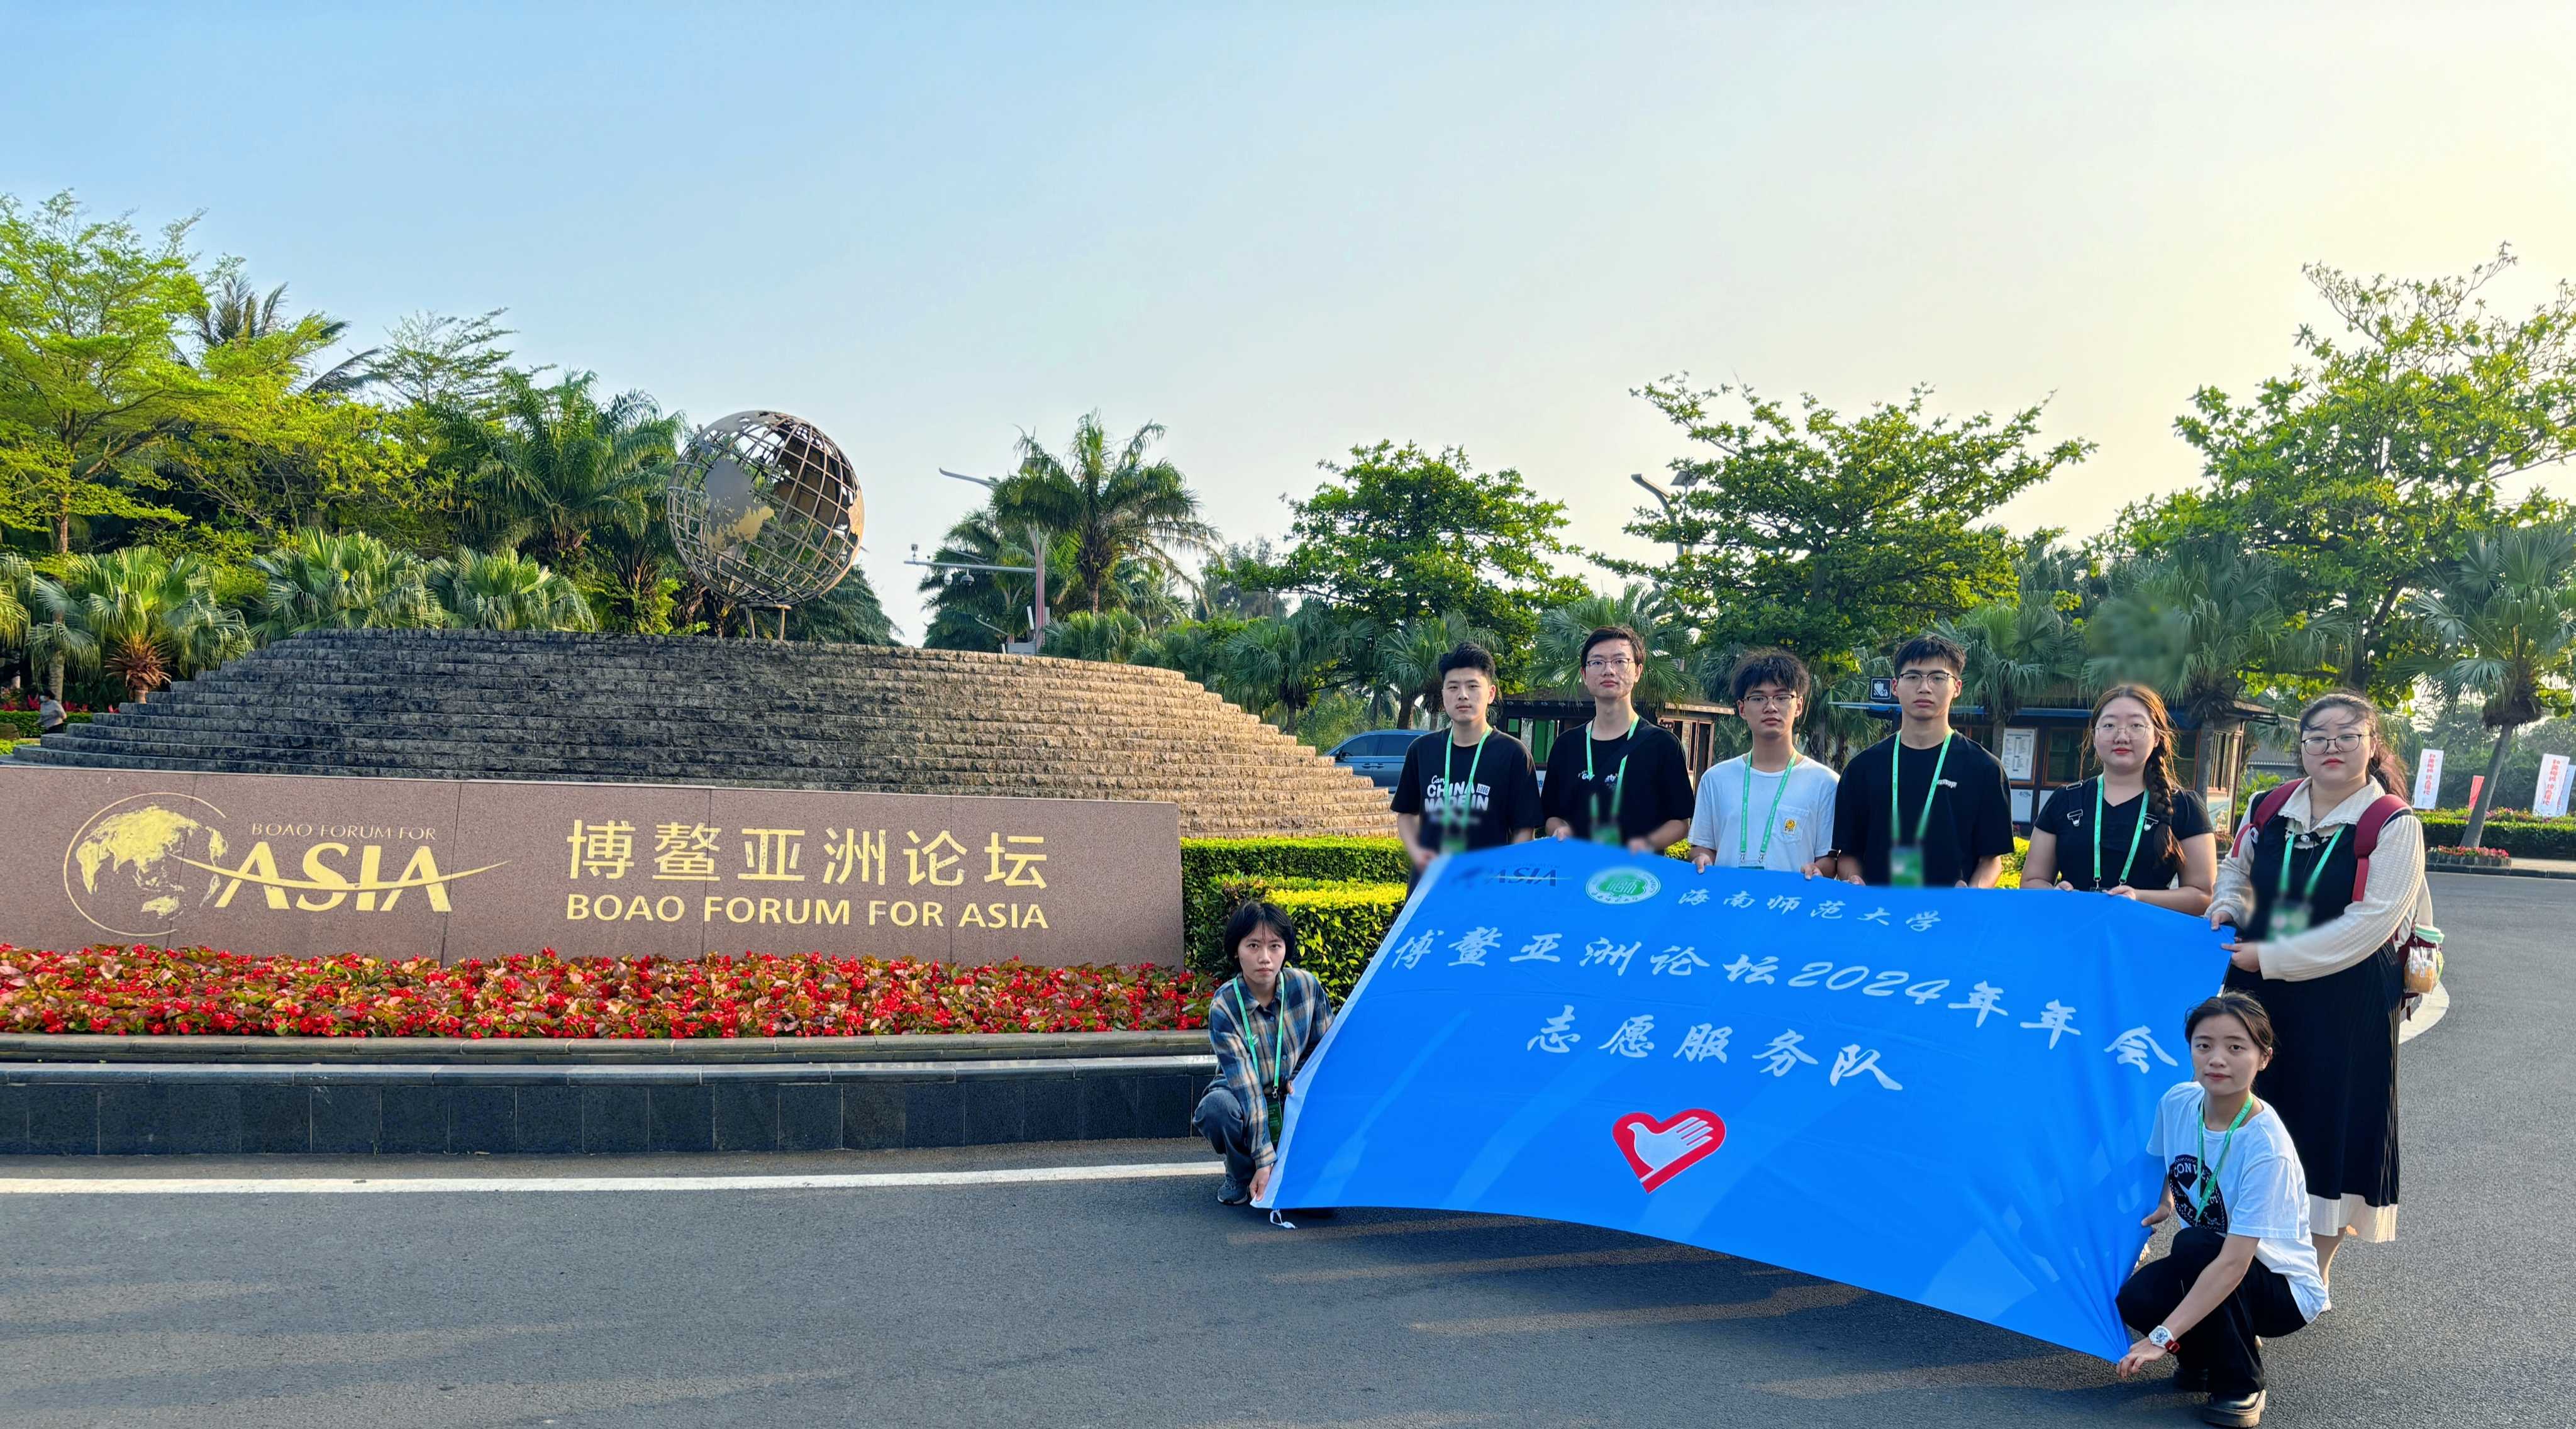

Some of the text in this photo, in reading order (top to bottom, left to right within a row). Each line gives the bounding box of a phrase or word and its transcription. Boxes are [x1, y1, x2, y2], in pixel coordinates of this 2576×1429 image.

[1427, 781, 1475, 798] CHINA
[1471, 794, 1489, 811] IN
[252, 823, 435, 840] BOAO FORUM FOR
[214, 841, 452, 912] ASIA
[567, 820, 1048, 889] 博鳌亚洲论坛
[567, 894, 1049, 930] BOAO FORUM FOR ASIA
[1678, 888, 1941, 932] 海南师范大学
[1392, 926, 2178, 1074] 博鳌亚洲论坛2024年年会
[1526, 1004, 1903, 1091] 志愿服务队
